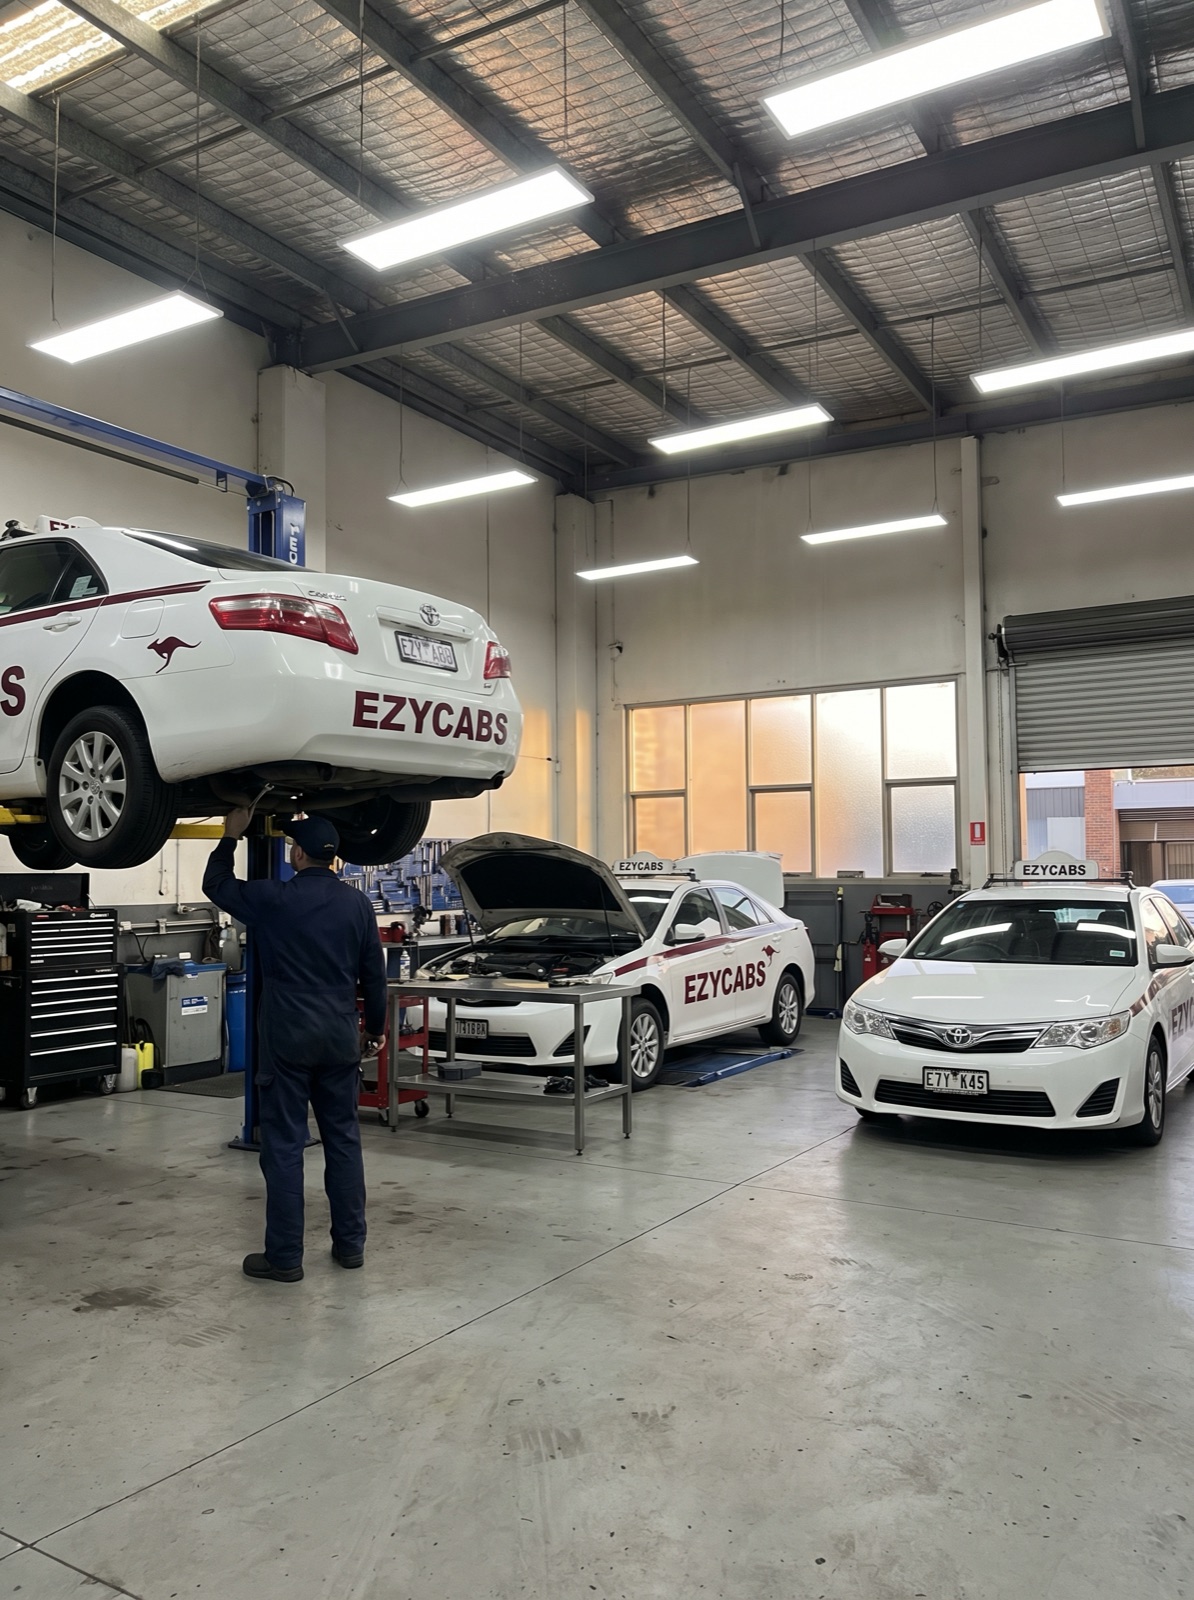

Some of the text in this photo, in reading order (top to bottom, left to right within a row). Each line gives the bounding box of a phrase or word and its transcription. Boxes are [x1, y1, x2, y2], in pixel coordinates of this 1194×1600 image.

[352, 690, 508, 746] EZYCABS
[619, 861, 664, 871] EZYCABS
[1022, 864, 1086, 876] EZYCABS
[684, 960, 766, 1005] EZYCABS
[926, 1071, 950, 1088] E7Y
